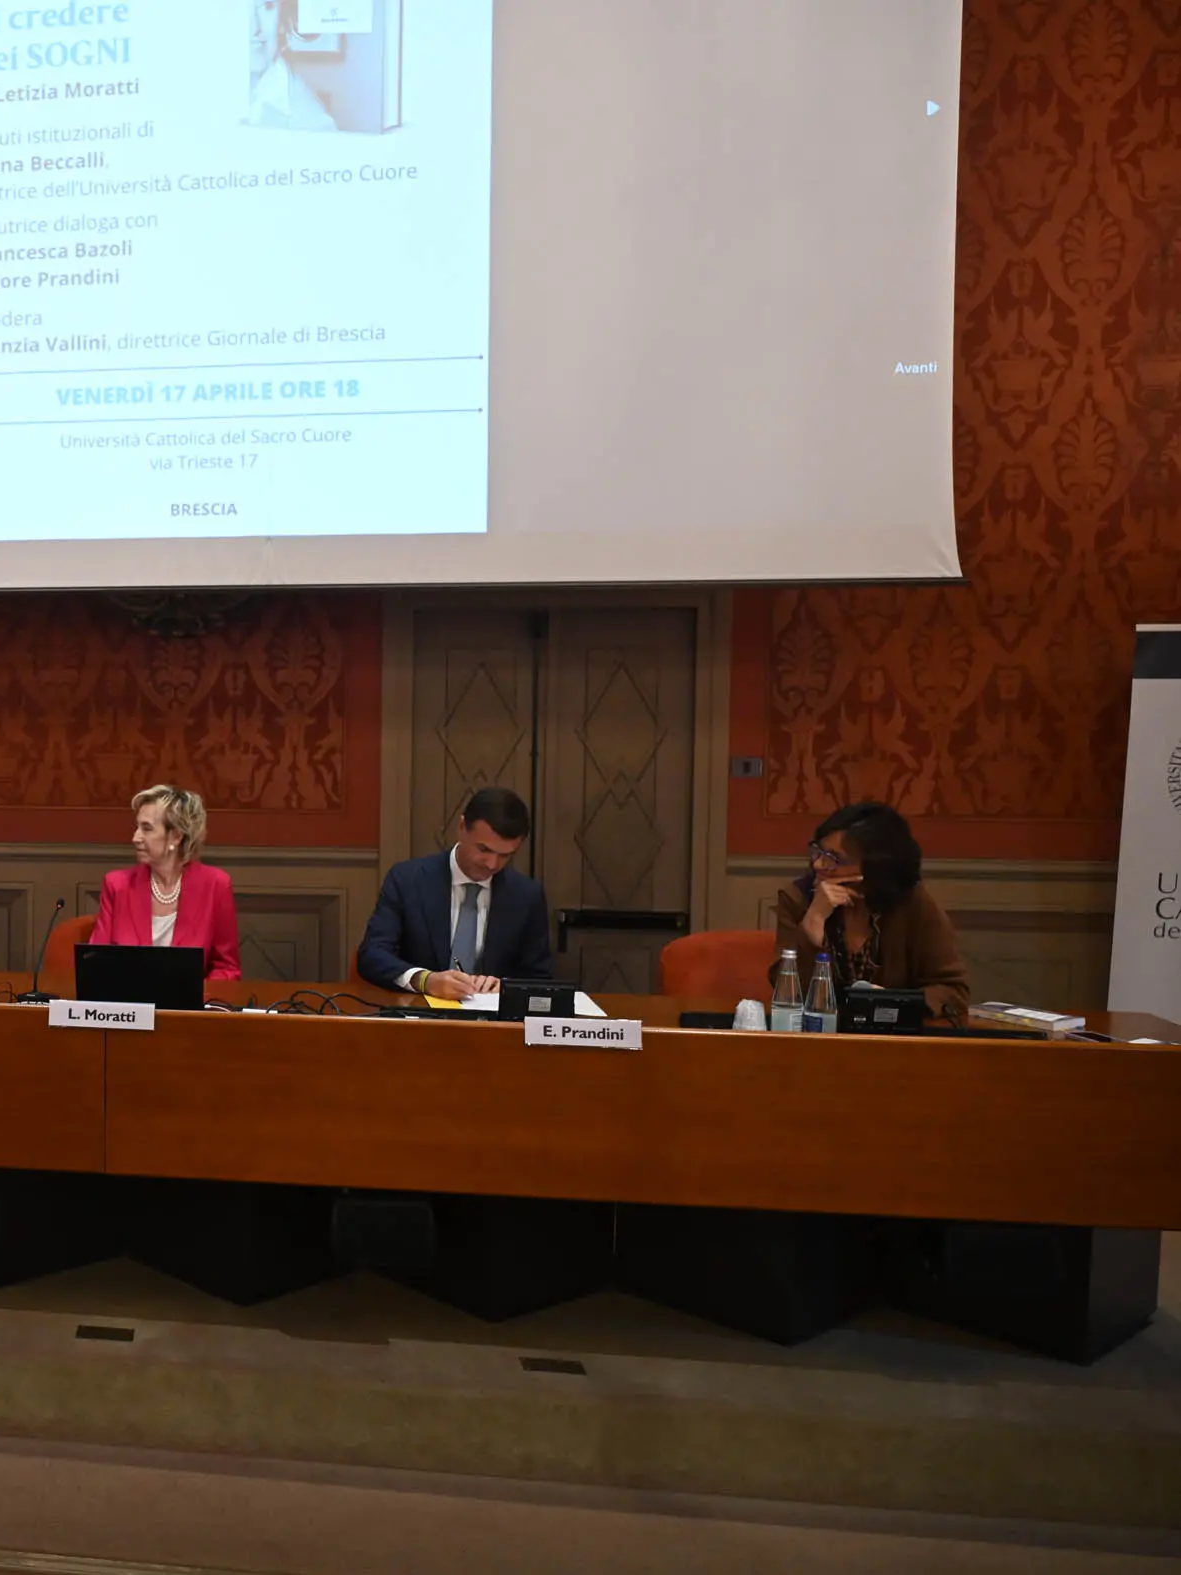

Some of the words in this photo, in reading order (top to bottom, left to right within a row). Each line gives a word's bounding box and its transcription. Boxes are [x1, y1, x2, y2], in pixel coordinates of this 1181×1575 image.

[8, 0, 129, 30] credere
[26, 37, 131, 69] SOGNI
[65, 78, 139, 99] Moratti
[27, 122, 131, 145] istituzionali
[137, 120, 153, 138] di
[177, 171, 259, 191] Cattolica
[265, 168, 293, 186] del
[300, 168, 353, 185] Sacro
[359, 165, 417, 181] Cuore
[53, 214, 119, 235] dialoga
[125, 215, 158, 229] con
[75, 240, 132, 258] Bazoli
[38, 268, 119, 287] Prandini
[46, 334, 112, 354] Vallini,
[117, 332, 201, 349] direttrice
[207, 328, 287, 346] Giornale
[293, 327, 310, 343] di
[317, 325, 385, 342] Brescia
[894, 361, 937, 374] Avanti
[56, 381, 154, 406] VENERDÌ
[160, 384, 186, 403] 17
[192, 381, 272, 402] APRILE
[279, 380, 326, 399] ORE
[333, 379, 360, 397] 18
[60, 433, 140, 450] Università
[145, 430, 216, 448] Cattolica
[221, 429, 245, 446] del
[250, 429, 296, 444] Sacro
[302, 428, 352, 443] Cuore
[150, 457, 172, 471] via
[177, 455, 235, 469] Trieste
[239, 453, 258, 468] 17
[171, 503, 238, 517] BRESCIA
[68, 1008, 80, 1020] L.
[84, 1009, 136, 1023] Moratti
[543, 1025, 557, 1037] E.
[562, 1026, 624, 1040] Prandini
